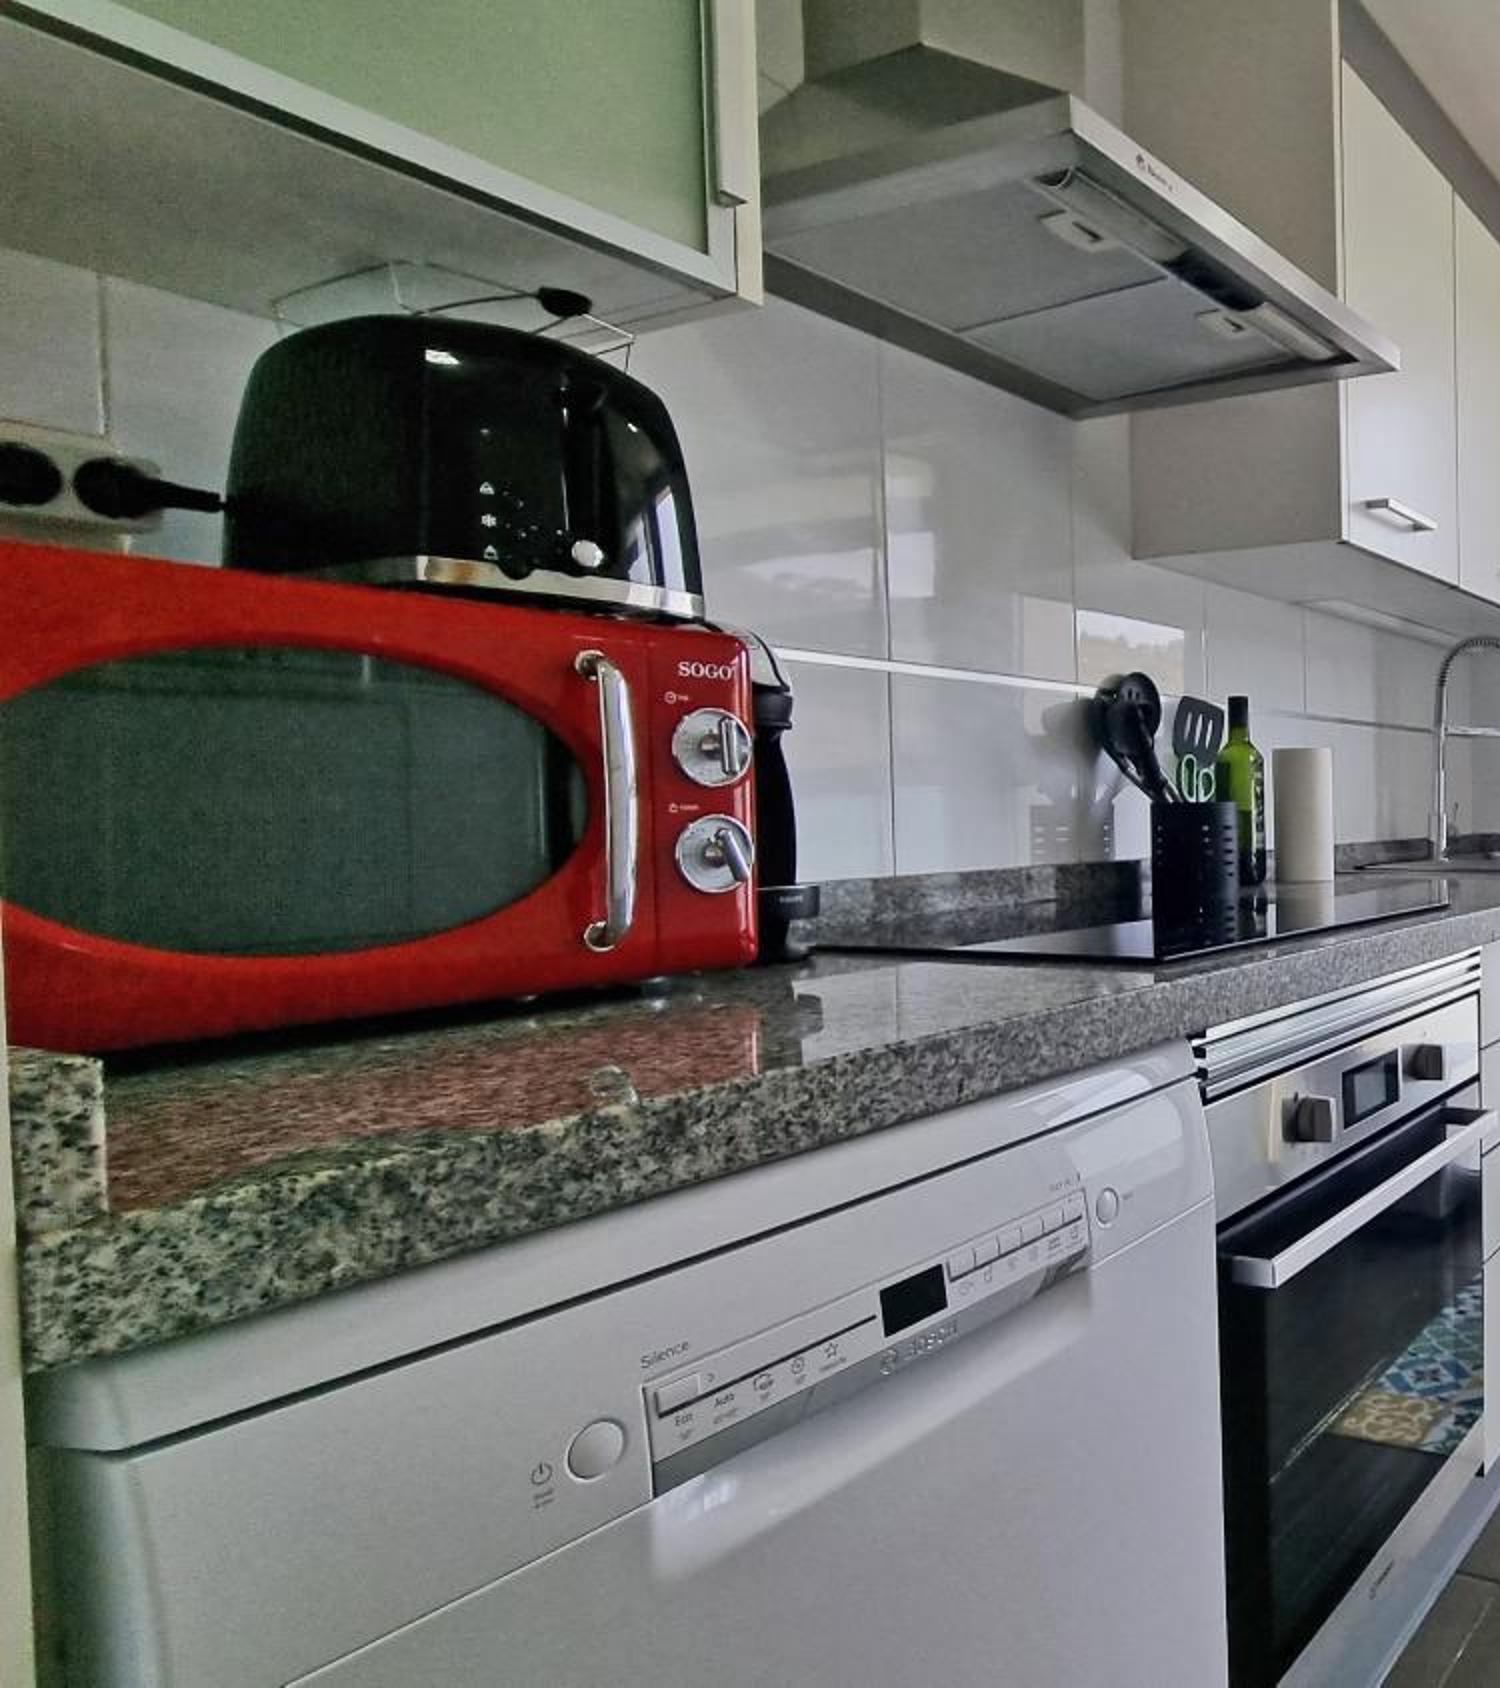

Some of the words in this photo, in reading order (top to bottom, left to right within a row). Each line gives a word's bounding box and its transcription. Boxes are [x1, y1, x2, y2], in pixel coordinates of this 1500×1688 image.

[677, 661, 732, 680] SOGO
[640, 1341, 689, 1369] Silence
[713, 1393, 735, 1408] Auto
